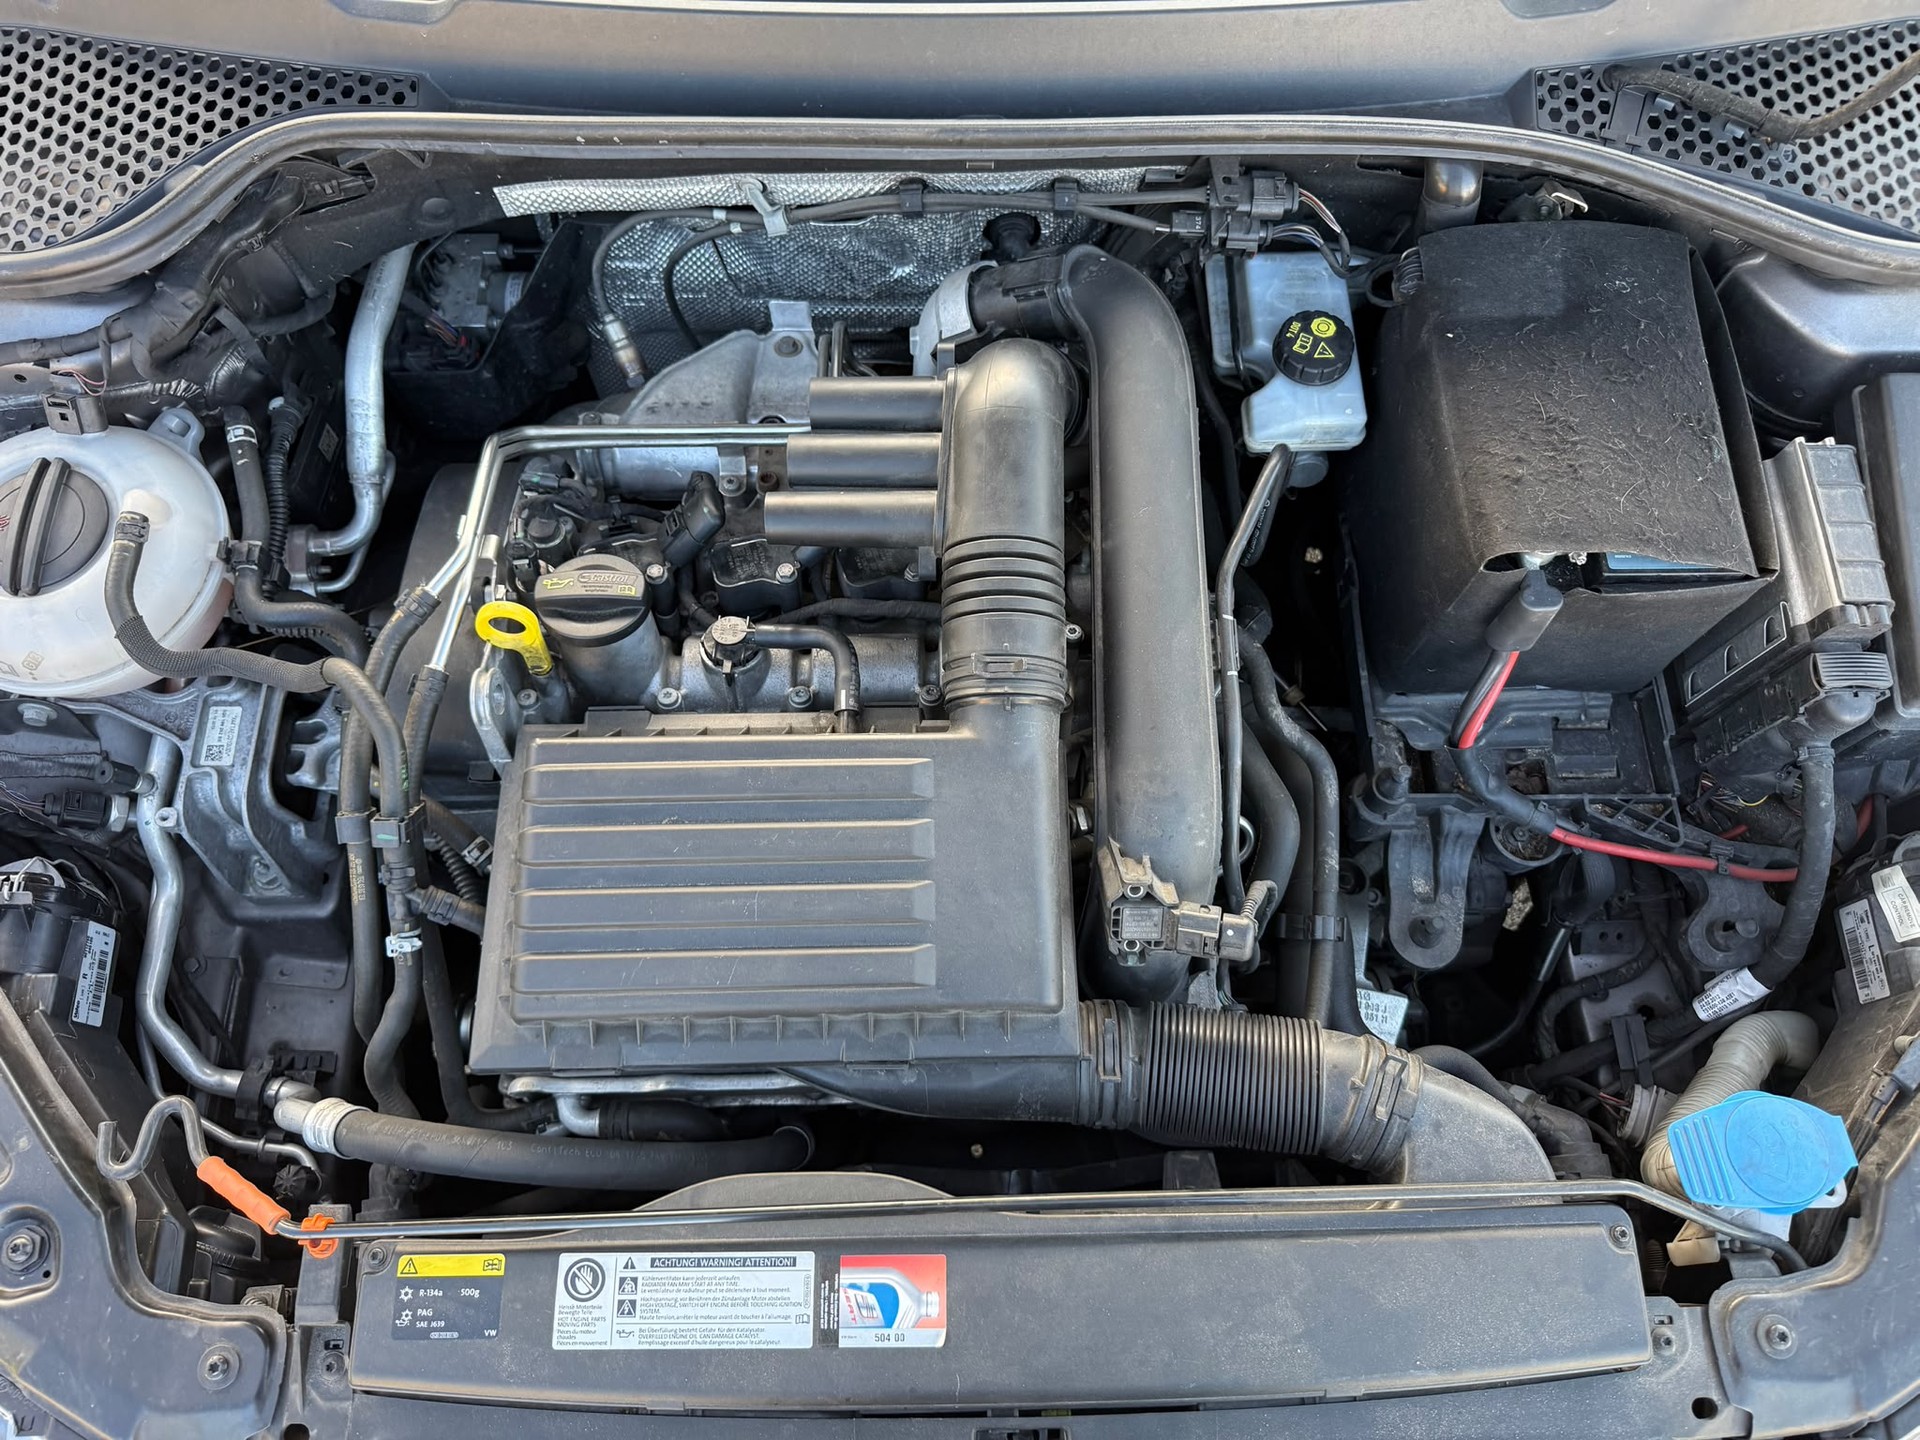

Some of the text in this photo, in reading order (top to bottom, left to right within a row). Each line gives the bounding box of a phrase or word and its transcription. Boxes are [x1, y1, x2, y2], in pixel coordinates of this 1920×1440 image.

[579, 572, 628, 582] Castrol
[654, 1258, 794, 1267] ACHTUNG! WARNING! ATTENTION!
[460, 1288, 480, 1298] 500g
[874, 1333, 905, 1342] 504 00
